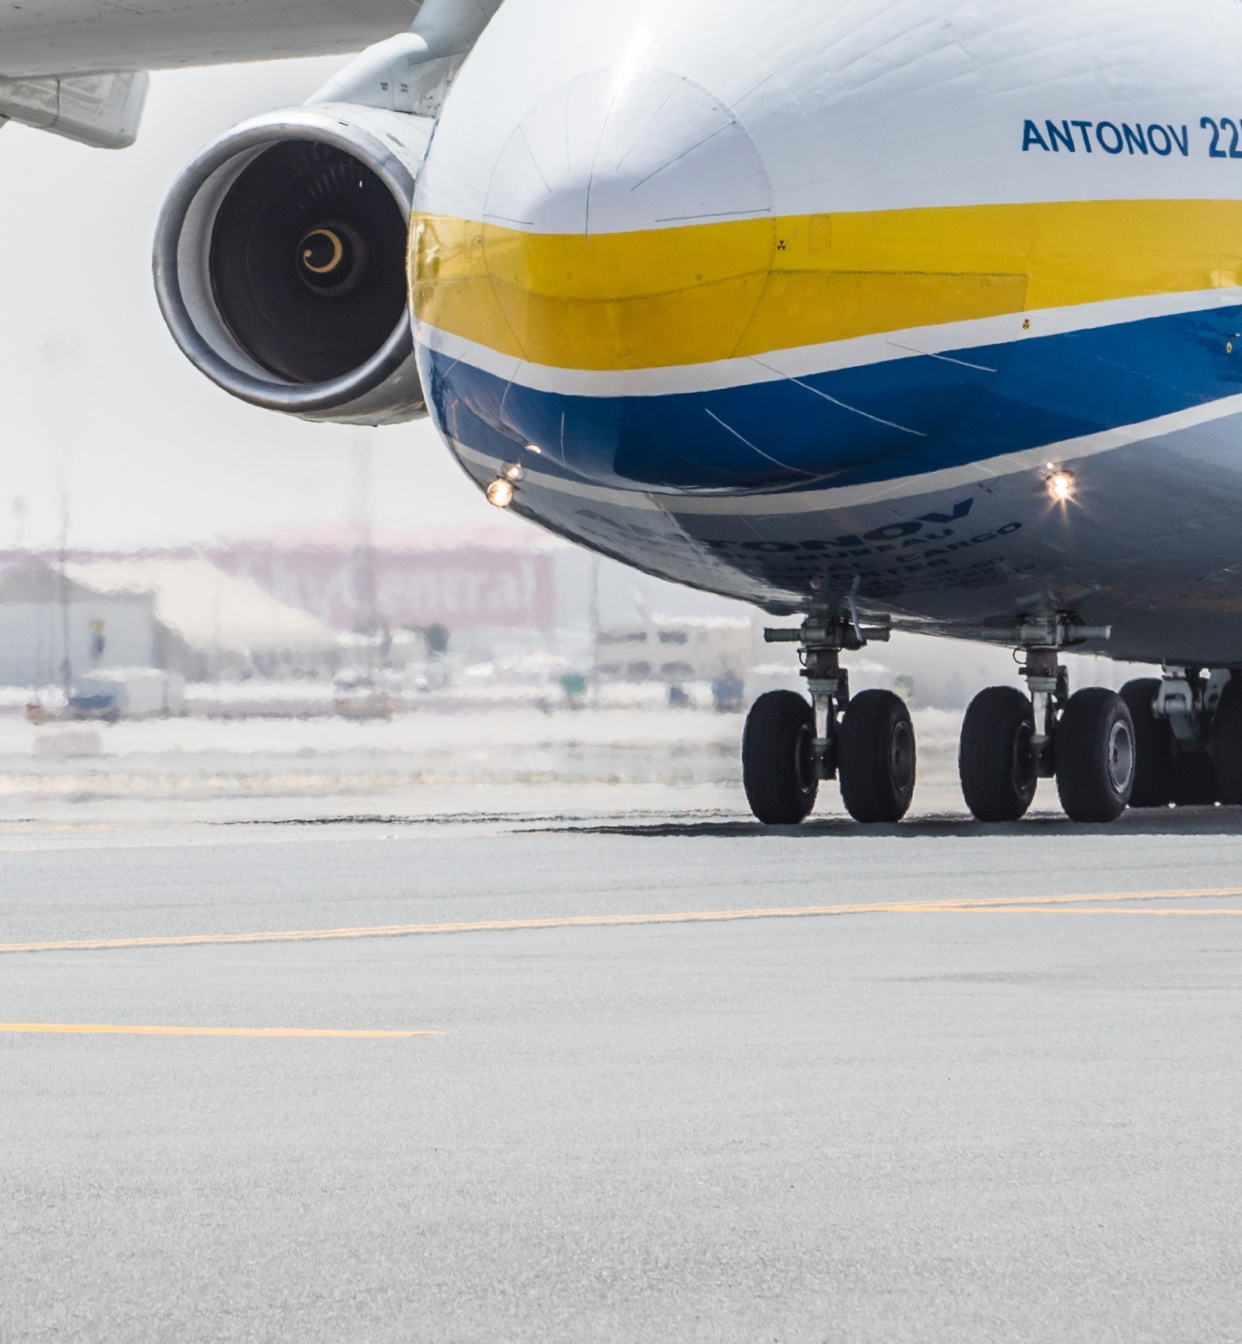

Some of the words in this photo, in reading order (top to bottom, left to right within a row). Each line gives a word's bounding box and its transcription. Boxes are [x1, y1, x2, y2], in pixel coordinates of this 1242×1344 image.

[1022, 119, 1188, 157] ANTONOV
[1200, 116, 1242, 159] 22
[895, 521, 1023, 563] CARGO
